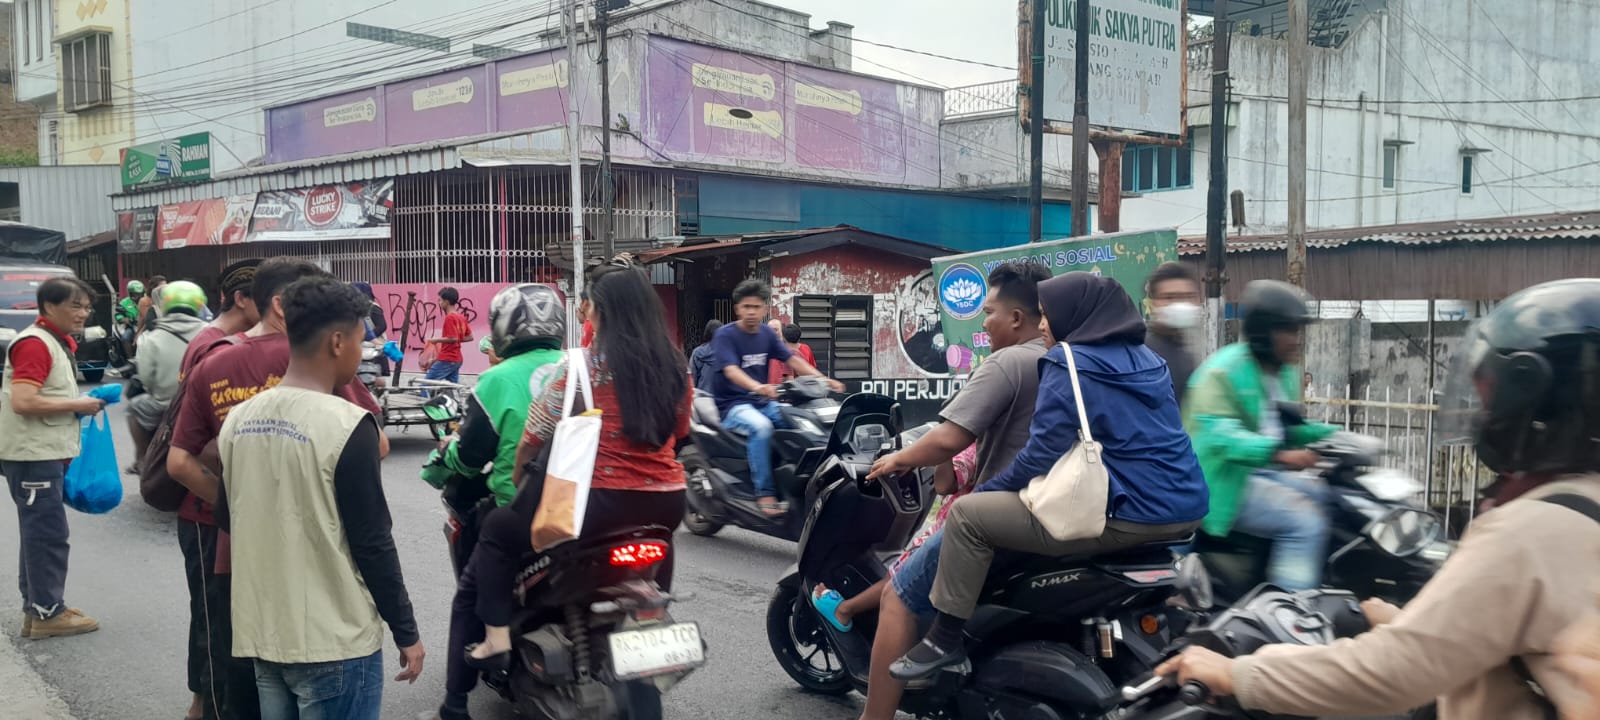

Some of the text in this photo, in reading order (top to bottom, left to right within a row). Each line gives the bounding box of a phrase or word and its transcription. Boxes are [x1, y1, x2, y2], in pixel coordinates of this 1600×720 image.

[1105, 9, 1140, 44] SAKYA
[1142, 16, 1176, 52] PUTRA
[181, 143, 209, 162] RAHMAN
[310, 201, 336, 216] STRIKE
[311, 191, 335, 206] LUCKY
[1055, 246, 1117, 267] SOSIAL
[894, 379, 969, 400] PERJUA
